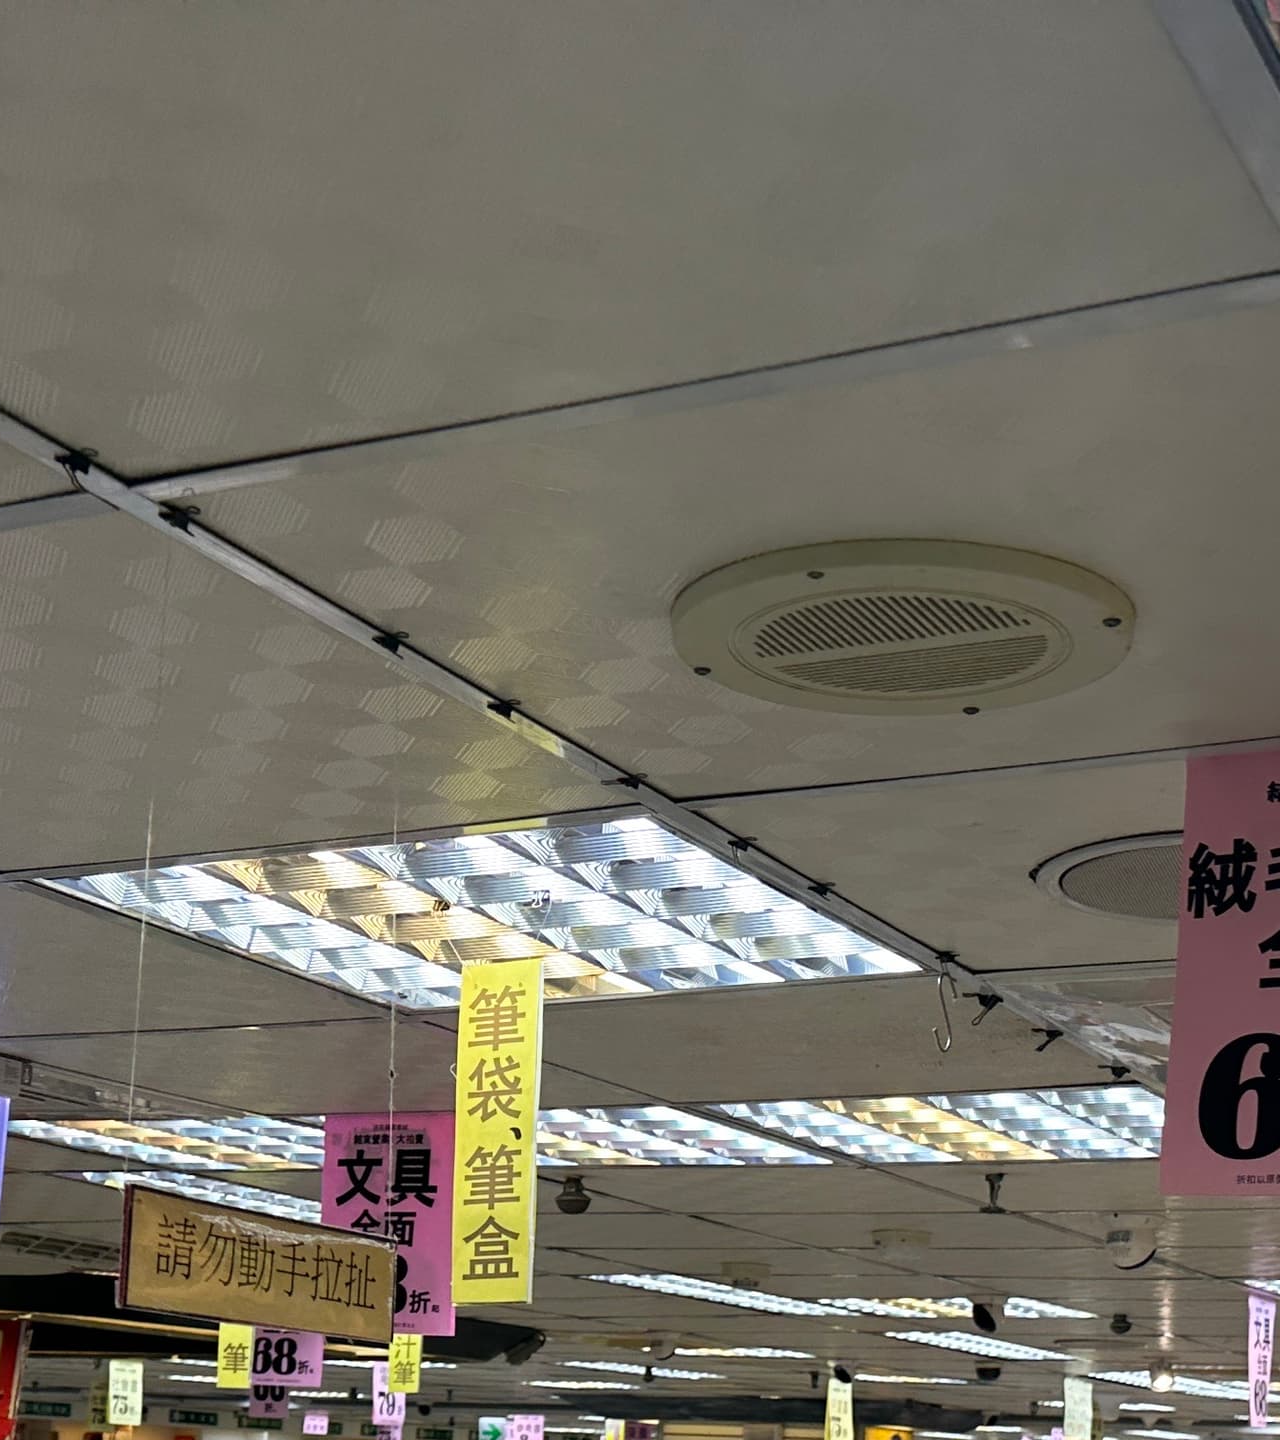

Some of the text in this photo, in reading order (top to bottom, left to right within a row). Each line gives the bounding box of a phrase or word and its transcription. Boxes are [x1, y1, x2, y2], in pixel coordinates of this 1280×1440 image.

[462, 984, 527, 1281] 筆袋、筆盒
[336, 1148, 437, 1207] 文具
[155, 1217, 376, 1311] 請勿動手拉扯
[222, 1343, 249, 1374] 筆
